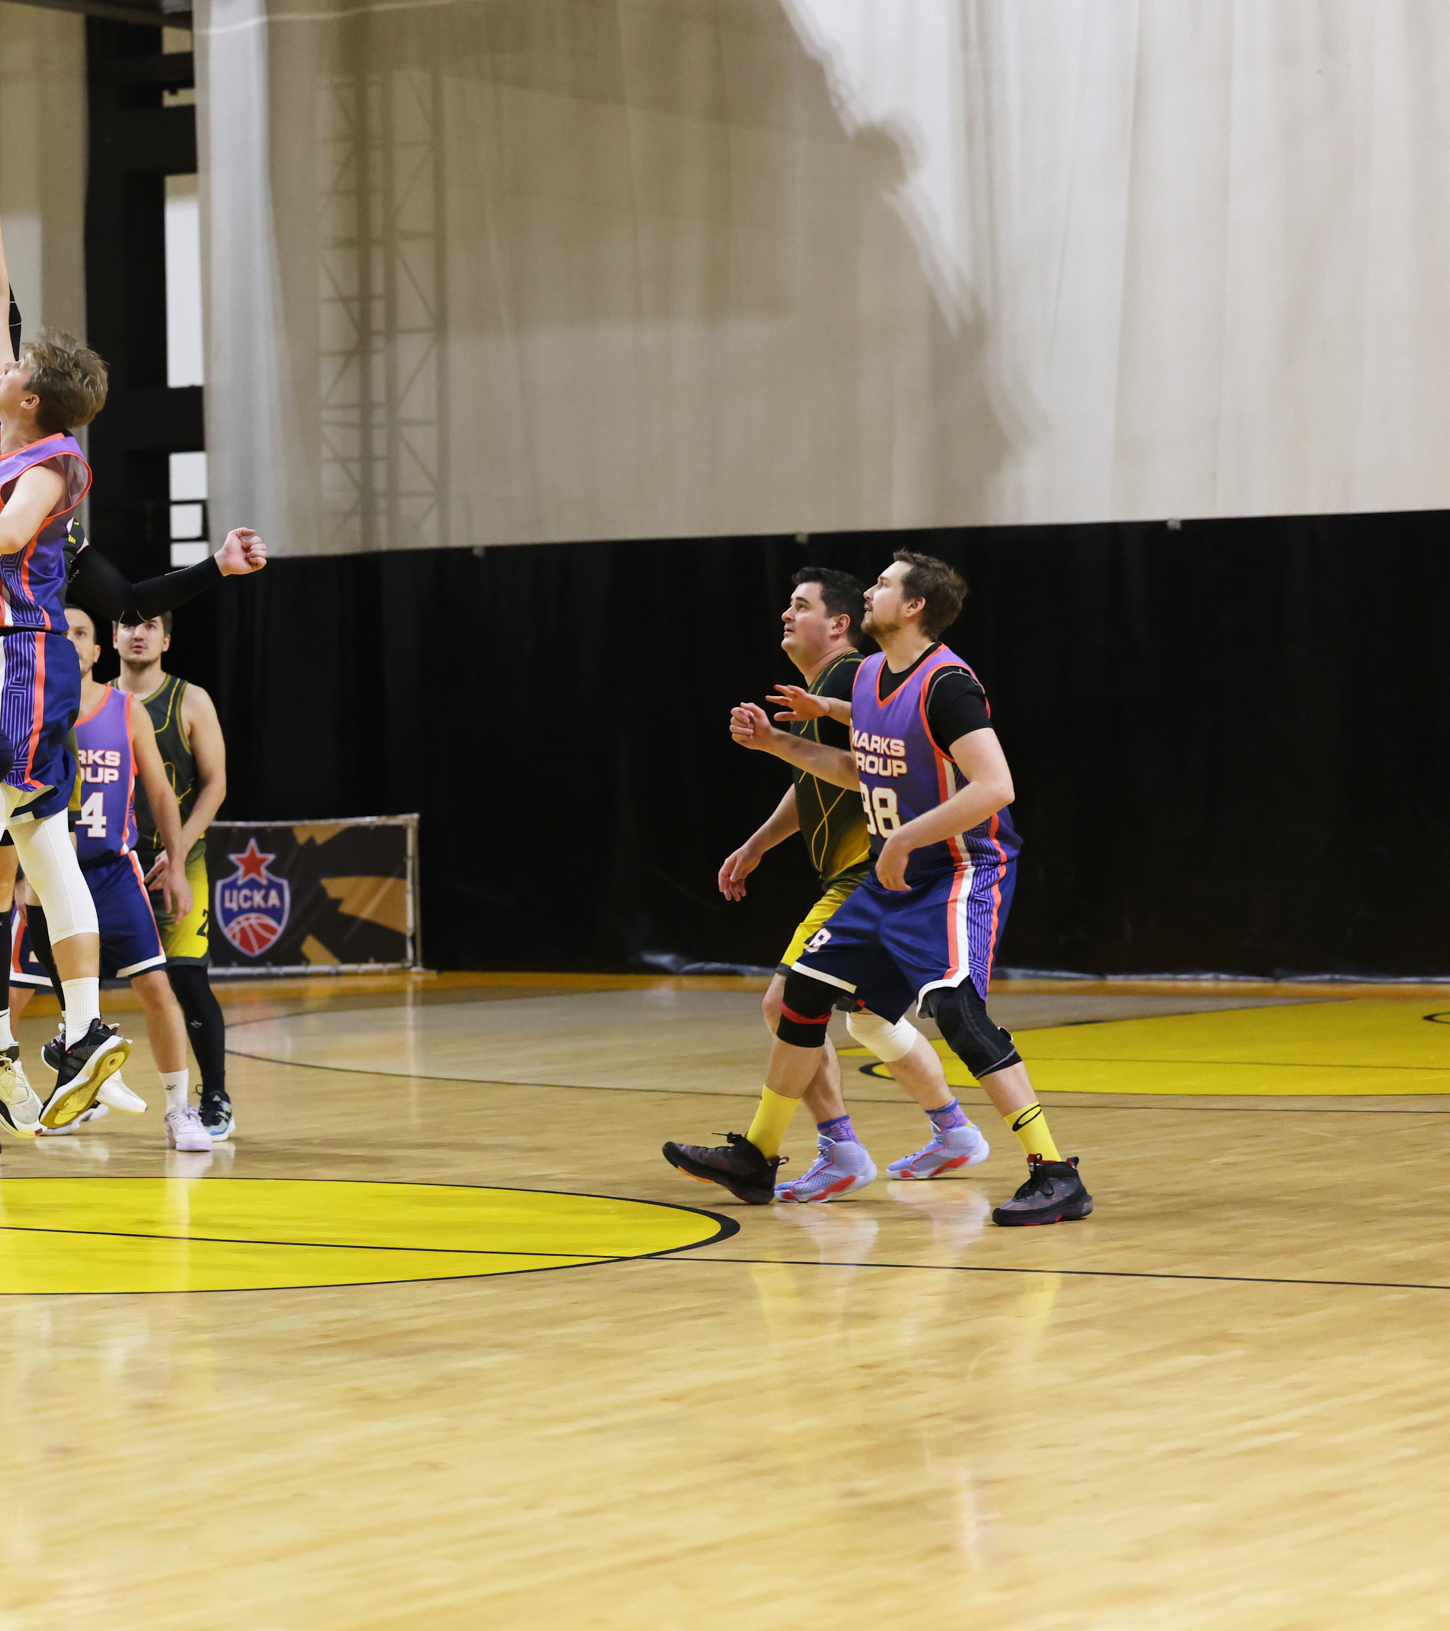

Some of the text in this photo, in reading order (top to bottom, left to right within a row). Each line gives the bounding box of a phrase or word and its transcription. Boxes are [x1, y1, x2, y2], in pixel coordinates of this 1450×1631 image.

[77, 749, 121, 767] RKS
[855, 750, 908, 777] ROUP
[224, 889, 281, 912] ЦСКА
